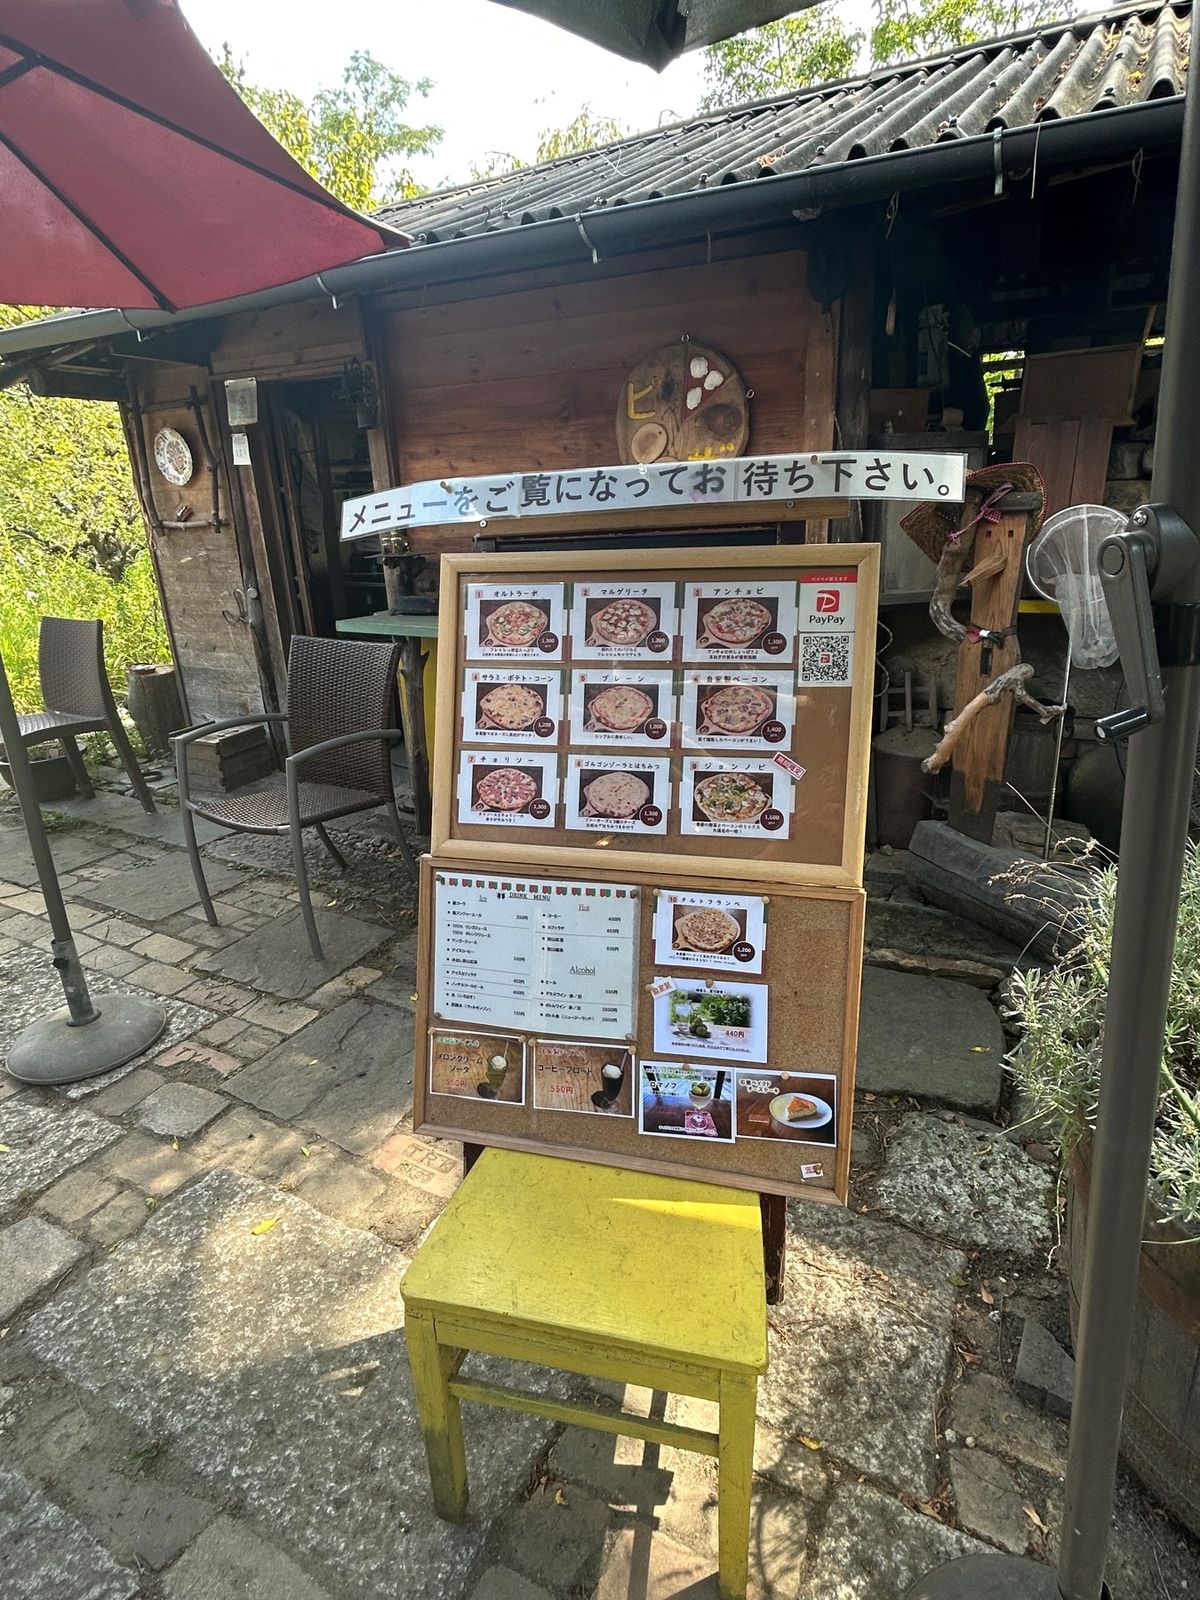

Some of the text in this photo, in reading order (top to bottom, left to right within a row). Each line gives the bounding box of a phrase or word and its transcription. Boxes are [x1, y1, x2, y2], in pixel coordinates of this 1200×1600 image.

[349, 458, 950, 533] メニューをご覧になってお待ち下さい。
[809, 615, 846, 625] PayPay
[707, 675, 768, 683] 自家製ベーコン
[584, 760, 660, 769] ゴルゴンゾーラとはちみつ
[705, 762, 766, 770] ジョンノビ
[681, 897, 741, 906] タルトフランベ
[578, 904, 590, 912] Hot
[569, 965, 596, 975] Alcohol
[726, 1030, 745, 1038] 440円
[437, 1053, 483, 1065] メロンクリーム
[537, 1064, 593, 1075] コーヒーフロート
[446, 1079, 468, 1088] 550円
[650, 1081, 677, 1089] ロマノフ
[550, 1085, 574, 1094] 550円
